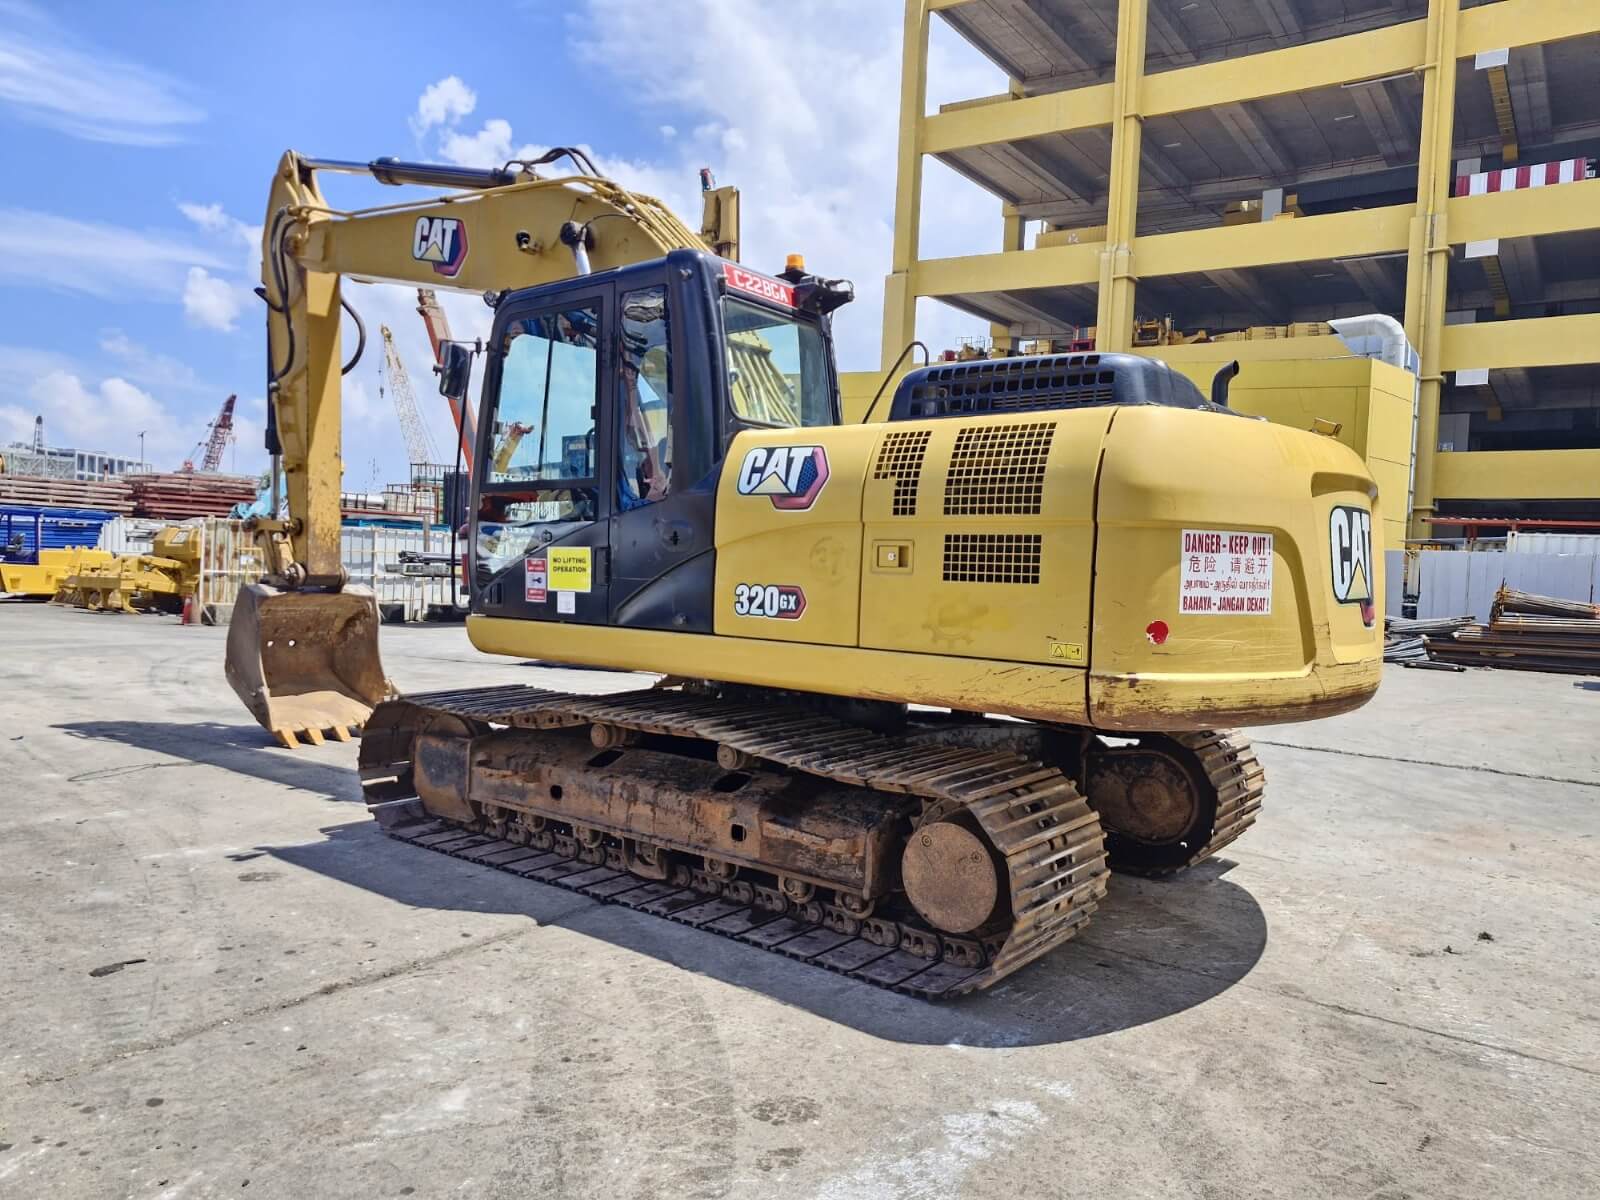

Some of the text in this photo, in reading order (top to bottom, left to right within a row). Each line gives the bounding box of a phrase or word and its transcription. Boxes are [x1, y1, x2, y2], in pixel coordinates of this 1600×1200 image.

[413, 217, 458, 262] CAT
[737, 447, 814, 494] CAT
[1184, 533, 1221, 553] DANGER
[1229, 535, 1249, 554] KEEP
[1330, 507, 1372, 600] CAT
[1183, 596, 1212, 611] BAHAYA
[1217, 597, 1245, 611] JANGAN
